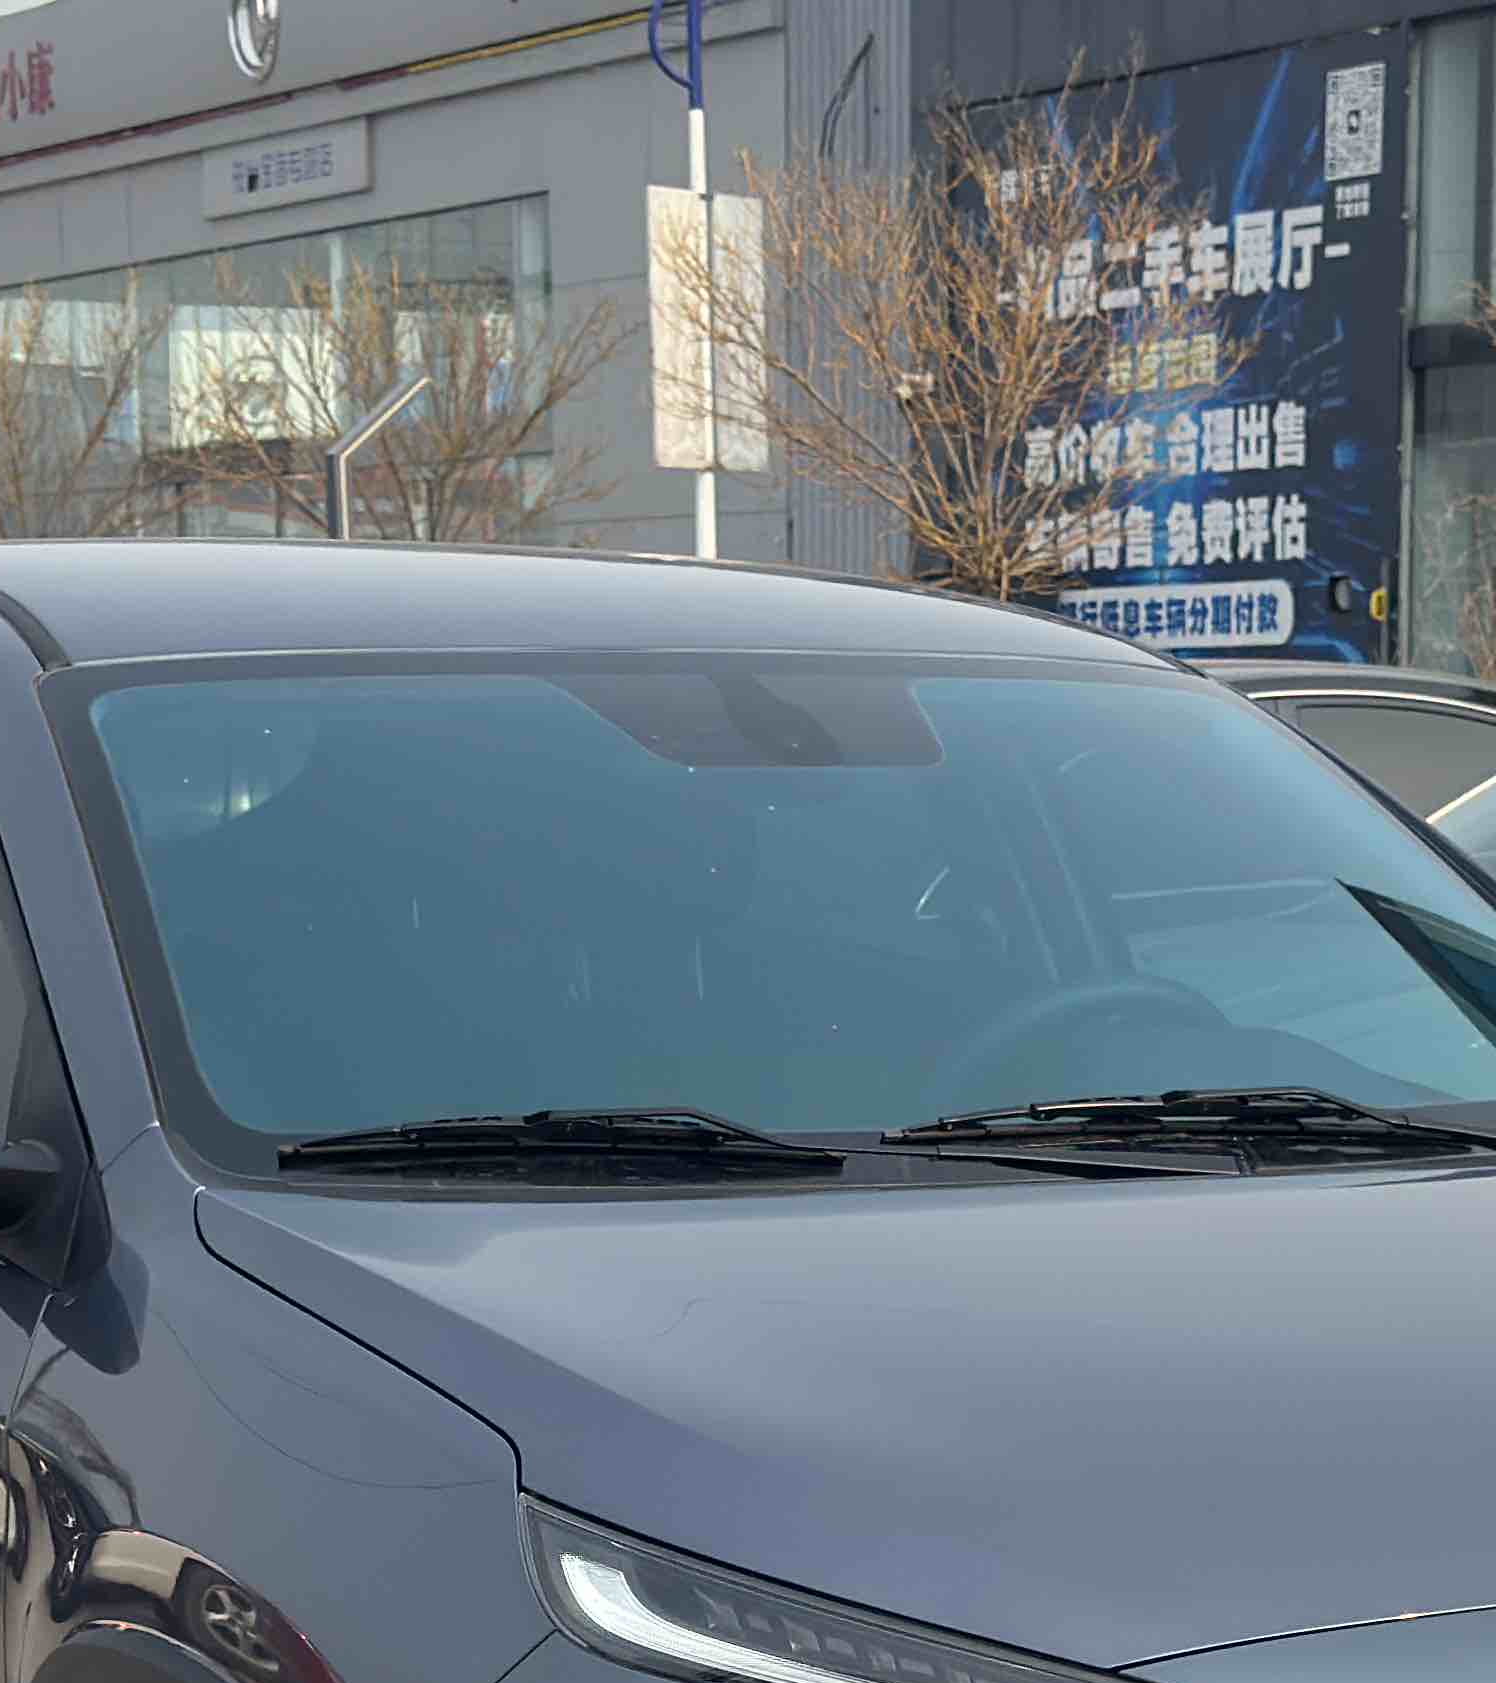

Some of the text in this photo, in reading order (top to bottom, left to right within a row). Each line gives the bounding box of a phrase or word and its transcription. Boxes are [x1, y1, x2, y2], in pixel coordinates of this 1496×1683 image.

[1166, 399, 1307, 476] 合理出售
[1166, 492, 1308, 568] 免费评估
